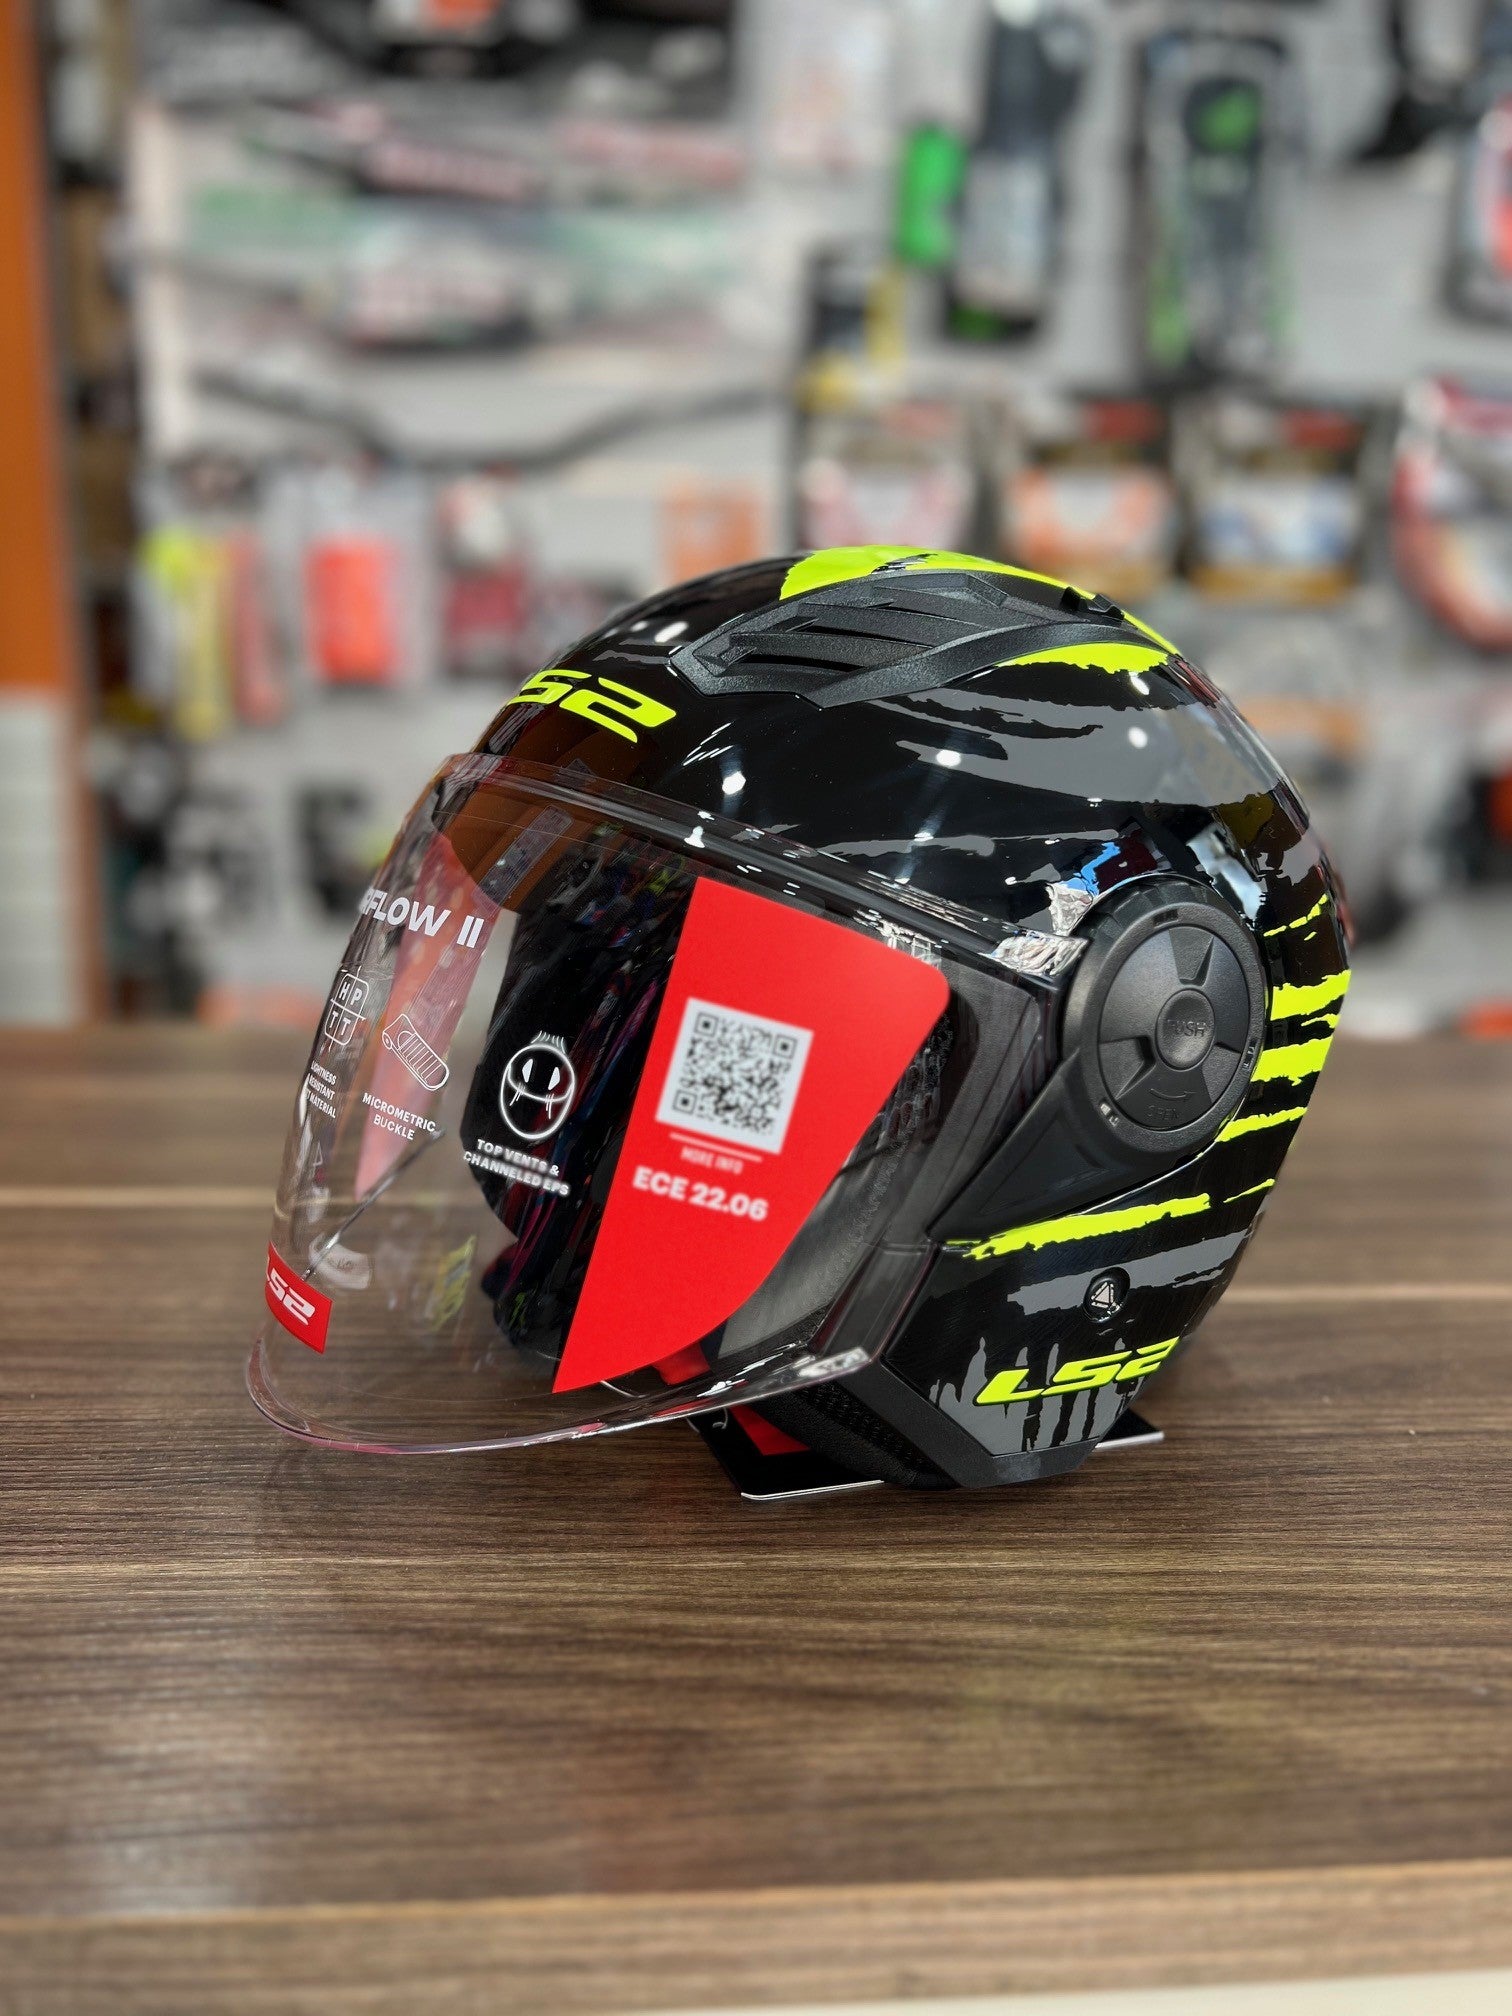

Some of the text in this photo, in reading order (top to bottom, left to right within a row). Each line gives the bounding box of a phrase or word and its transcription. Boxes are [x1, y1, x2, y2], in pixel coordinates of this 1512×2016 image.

[309, 1092, 337, 1119] MATERIAL
[362, 1092, 436, 1132] MICROMETRIC
[373, 1113, 415, 1140] BUCKLE
[463, 1151, 570, 1197] CHANNELED EPS
[477, 1138, 560, 1176] TOP VENTS &
[680, 1145, 744, 1175] MORE INFO
[632, 1165, 769, 1222] ECE 22.06
[267, 1256, 316, 1326] S2
[975, 1335, 1180, 1405] LS2
